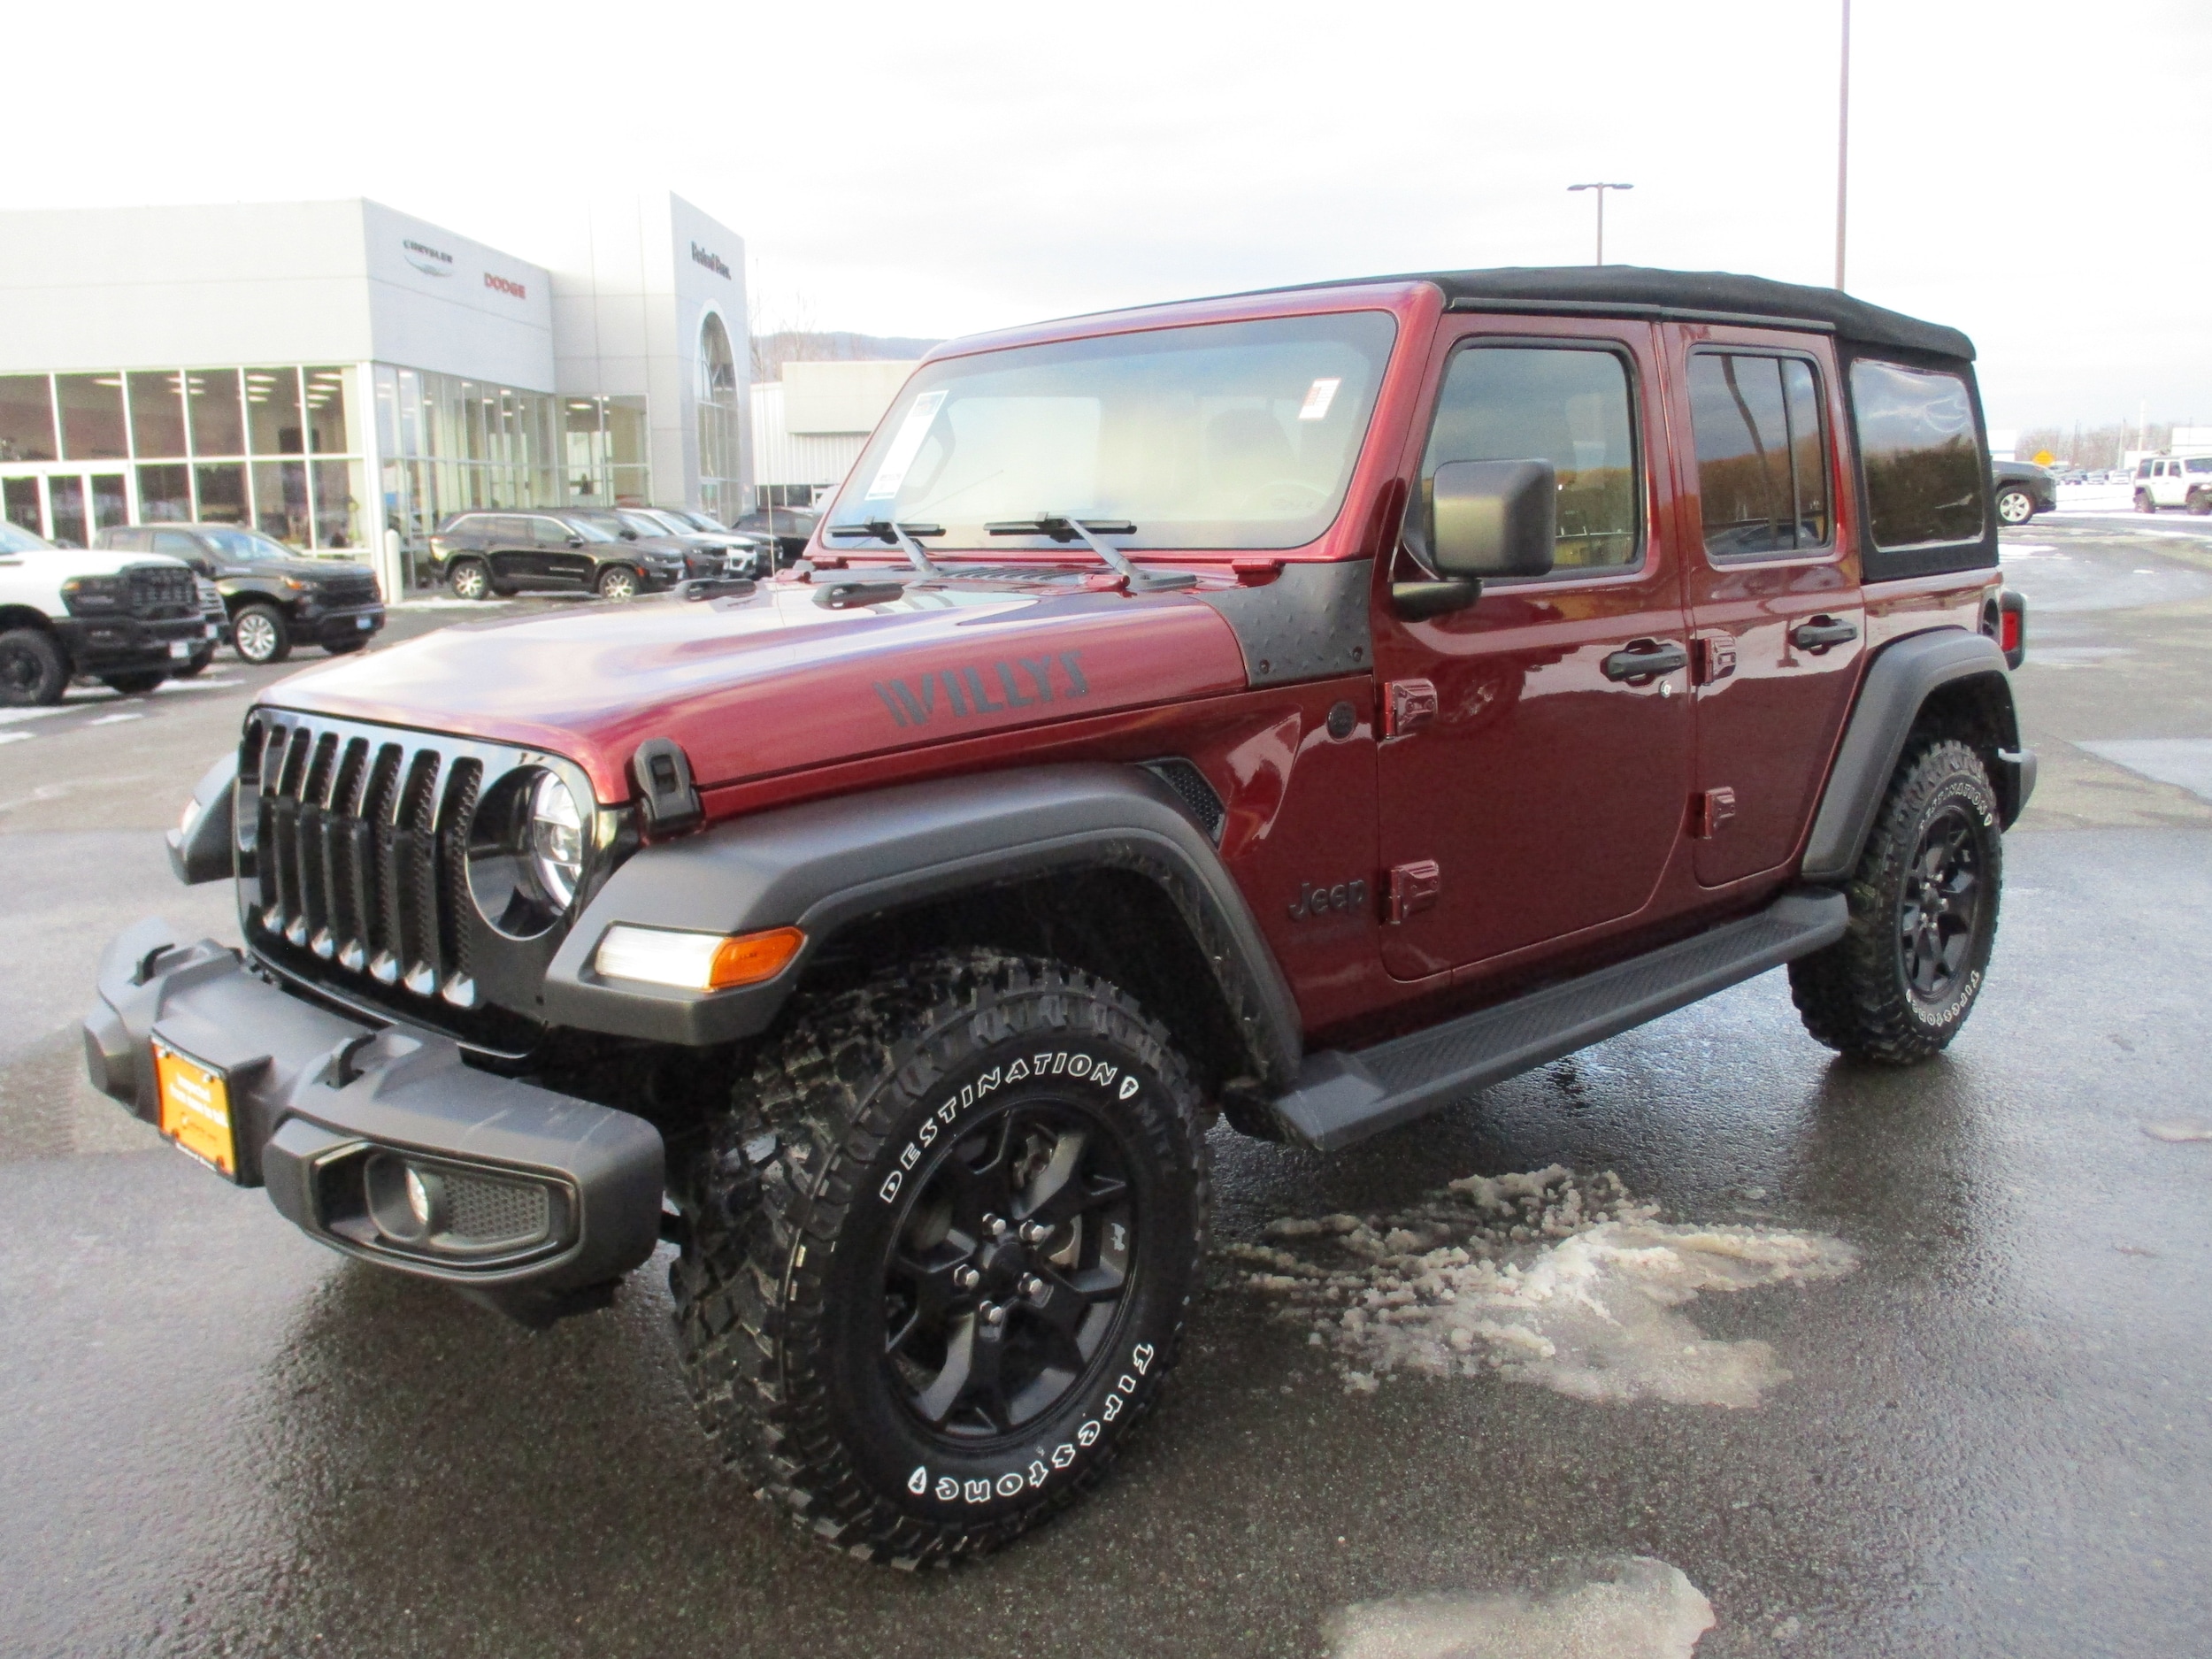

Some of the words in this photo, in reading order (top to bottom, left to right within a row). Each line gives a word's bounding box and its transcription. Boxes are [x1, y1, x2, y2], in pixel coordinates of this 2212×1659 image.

[403, 239, 453, 263] CHRYSLER
[484, 272, 526, 299] DODGE
[872, 649, 1089, 727] WILLYS
[1288, 879, 1366, 920] Jeep
[879, 1052, 1119, 1203] DESTINATION
